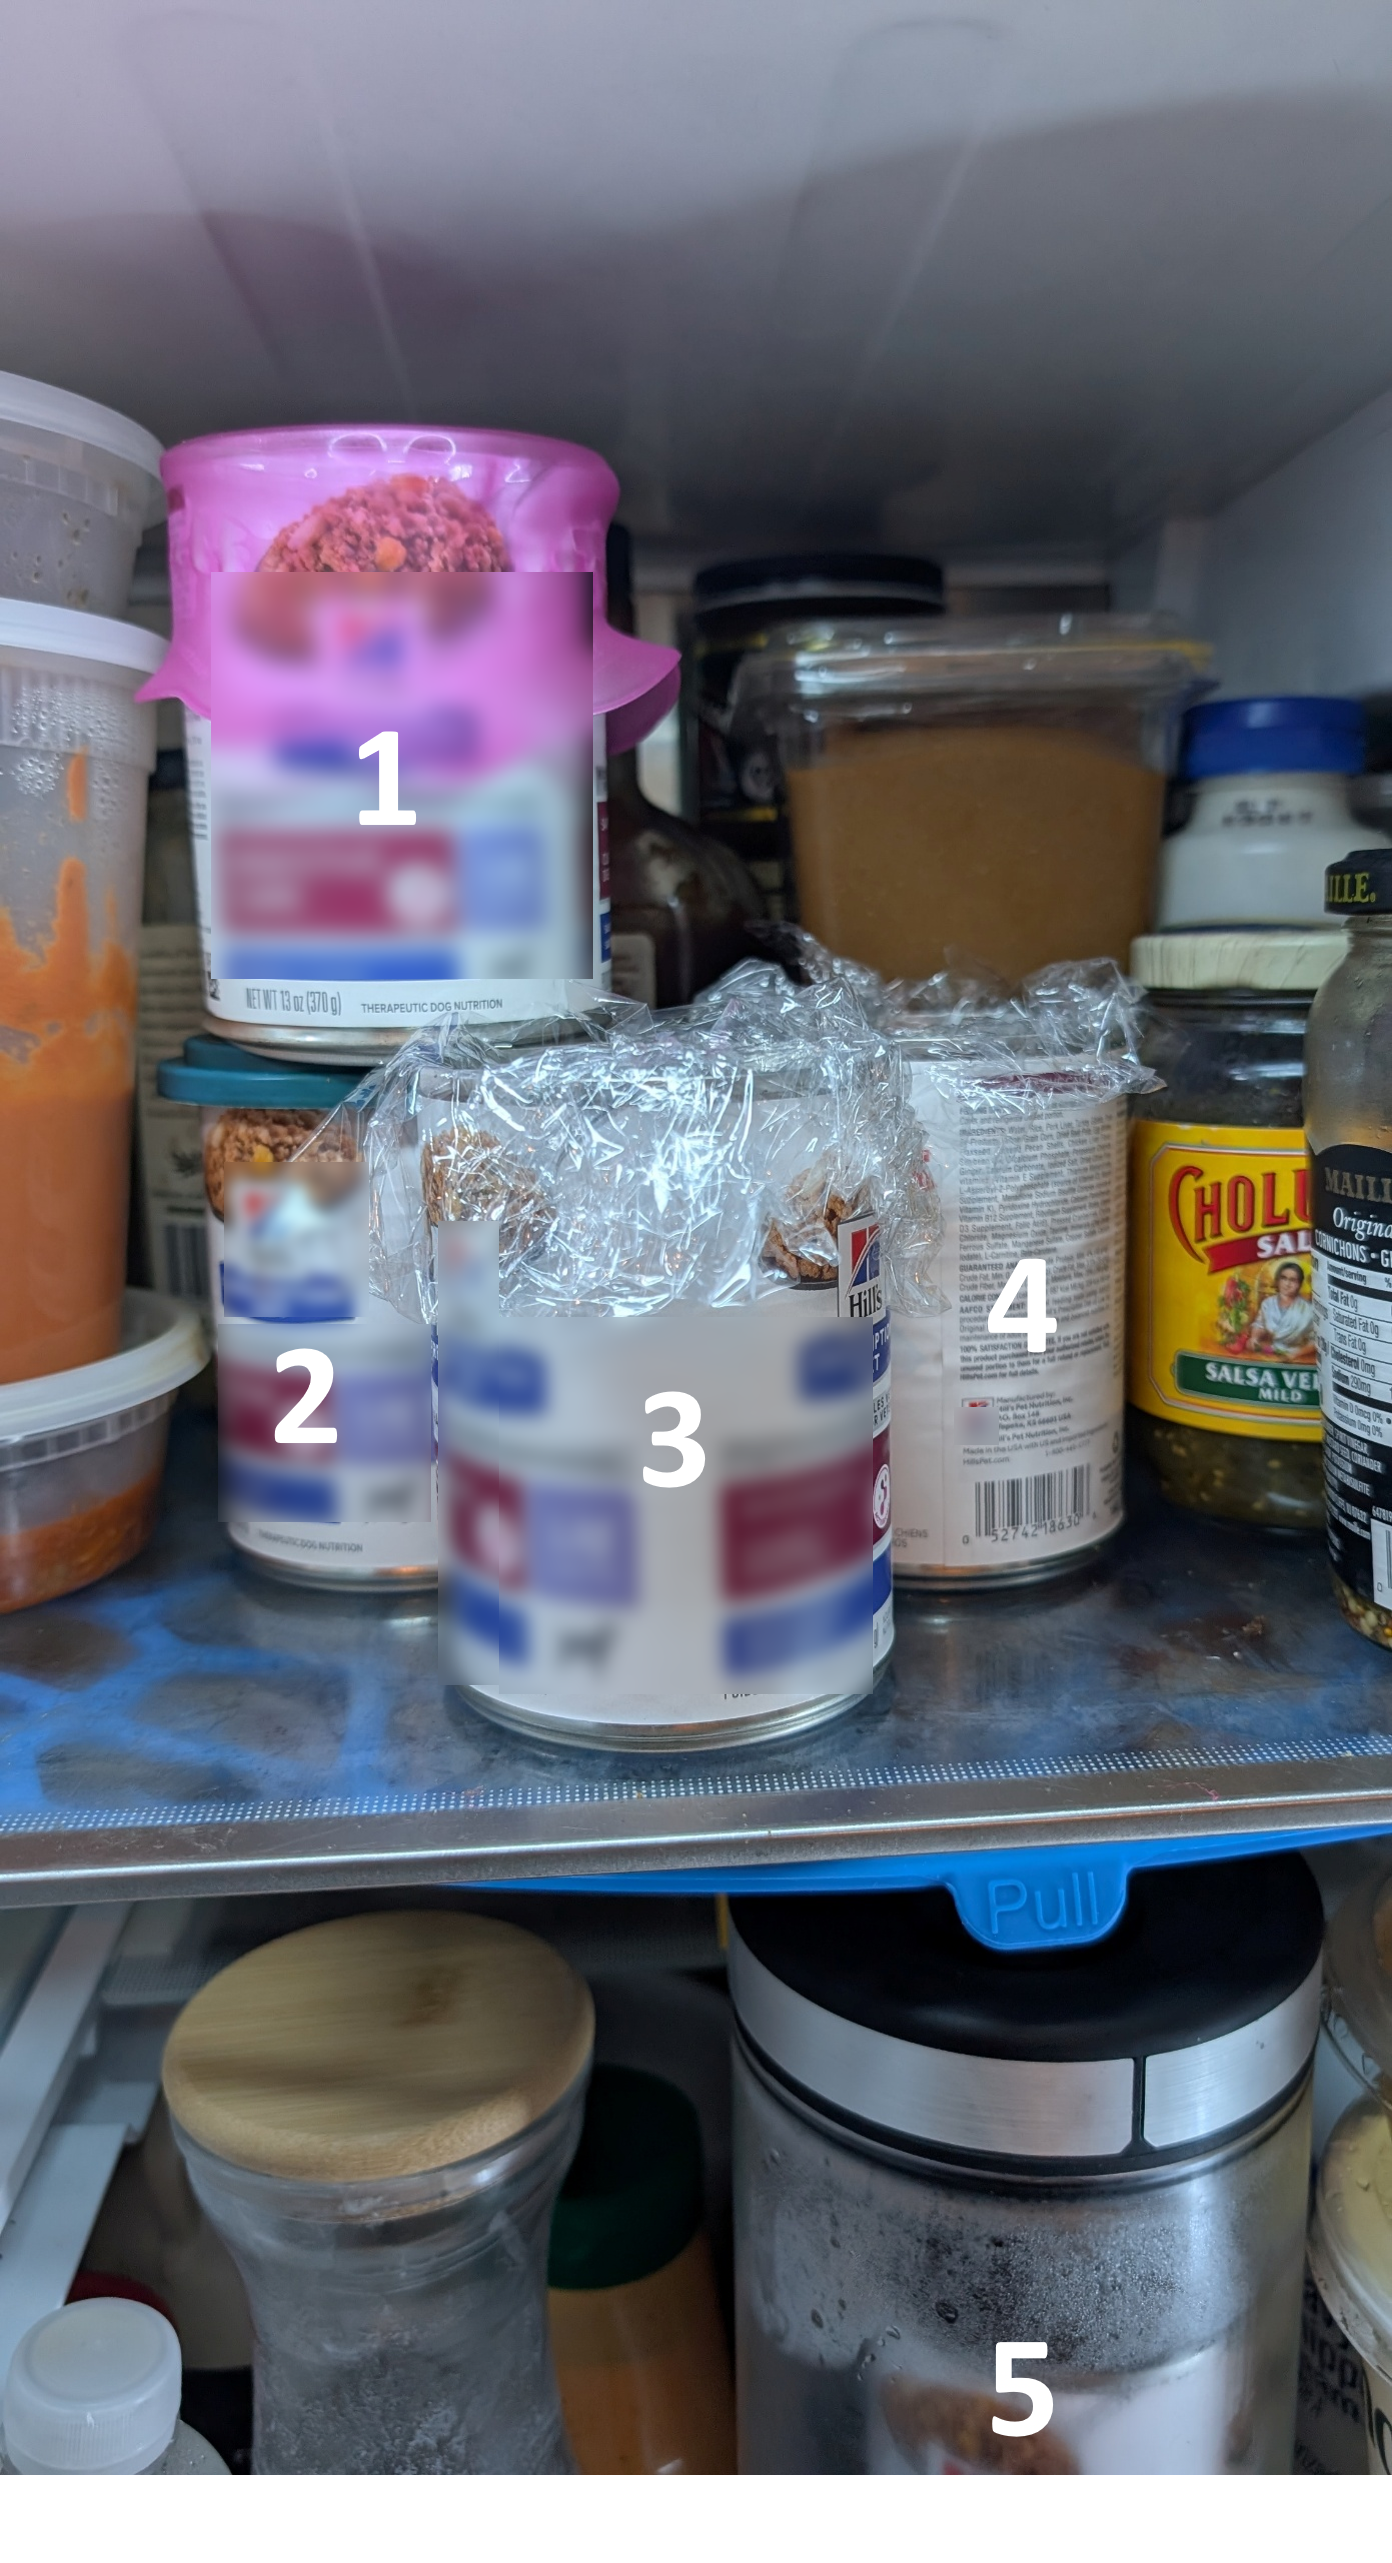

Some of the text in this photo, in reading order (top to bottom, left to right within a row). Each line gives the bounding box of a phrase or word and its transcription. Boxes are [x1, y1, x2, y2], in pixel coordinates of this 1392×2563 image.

[246, 988, 342, 1016] NET WT 13 oz (370 g)
[361, 998, 503, 1014] THERAPEUTIC DOG NUTRITION
[1324, 1166, 1392, 1205] MAILL
[985, 1214, 997, 1222] B12
[1333, 1206, 1392, 1241] Origina
[1314, 1228, 1369, 1264] CORNICHONS
[959, 1264, 1004, 1272] GUARANTEED
[849, 1284, 882, 1317] Hill's
[959, 1306, 983, 1314] AAFCO
[1340, 1292, 1350, 1307] Fat
[1350, 1295, 1358, 1313] 0g
[1332, 1307, 1357, 1329] Saturated
[1358, 1317, 1369, 1333] Fat
[1370, 1321, 1379, 1338] 0g
[959, 1345, 977, 1353] 100%
[980, 1341, 1022, 1351] SATISFACTION
[1347, 1334, 1358, 1350] Fat
[1358, 1338, 1366, 1356] 0g
[960, 1355, 972, 1363] this
[973, 1353, 998, 1363] product
[1205, 1362, 1275, 1387] SALSA
[1360, 1358, 1376, 1378] 0mg
[1258, 1388, 1302, 1402] MILD
[1350, 1375, 1371, 1397] 290mg
[1015, 1403, 1028, 1411] Pet
[1029, 1400, 1062, 1410] Nutrition,
[1354, 1405, 1371, 1422] 0mcg
[1372, 1411, 1383, 1424] 0%
[1013, 1413, 1027, 1421] Box
[1012, 1432, 1024, 1440] Pet
[1357, 1419, 1371, 1437] 0mg
[1371, 1424, 1383, 1438] 0%
[963, 1447, 985, 1455] Made
[995, 1445, 1007, 1453] the
[1008, 1444, 1023, 1452] USA
[1025, 1441, 1039, 1450] with
[963, 1457, 1010, 1466] HillsPet.com
[318, 1541, 363, 1553] NUTRITION
[988, 1871, 1098, 1934] Pull
